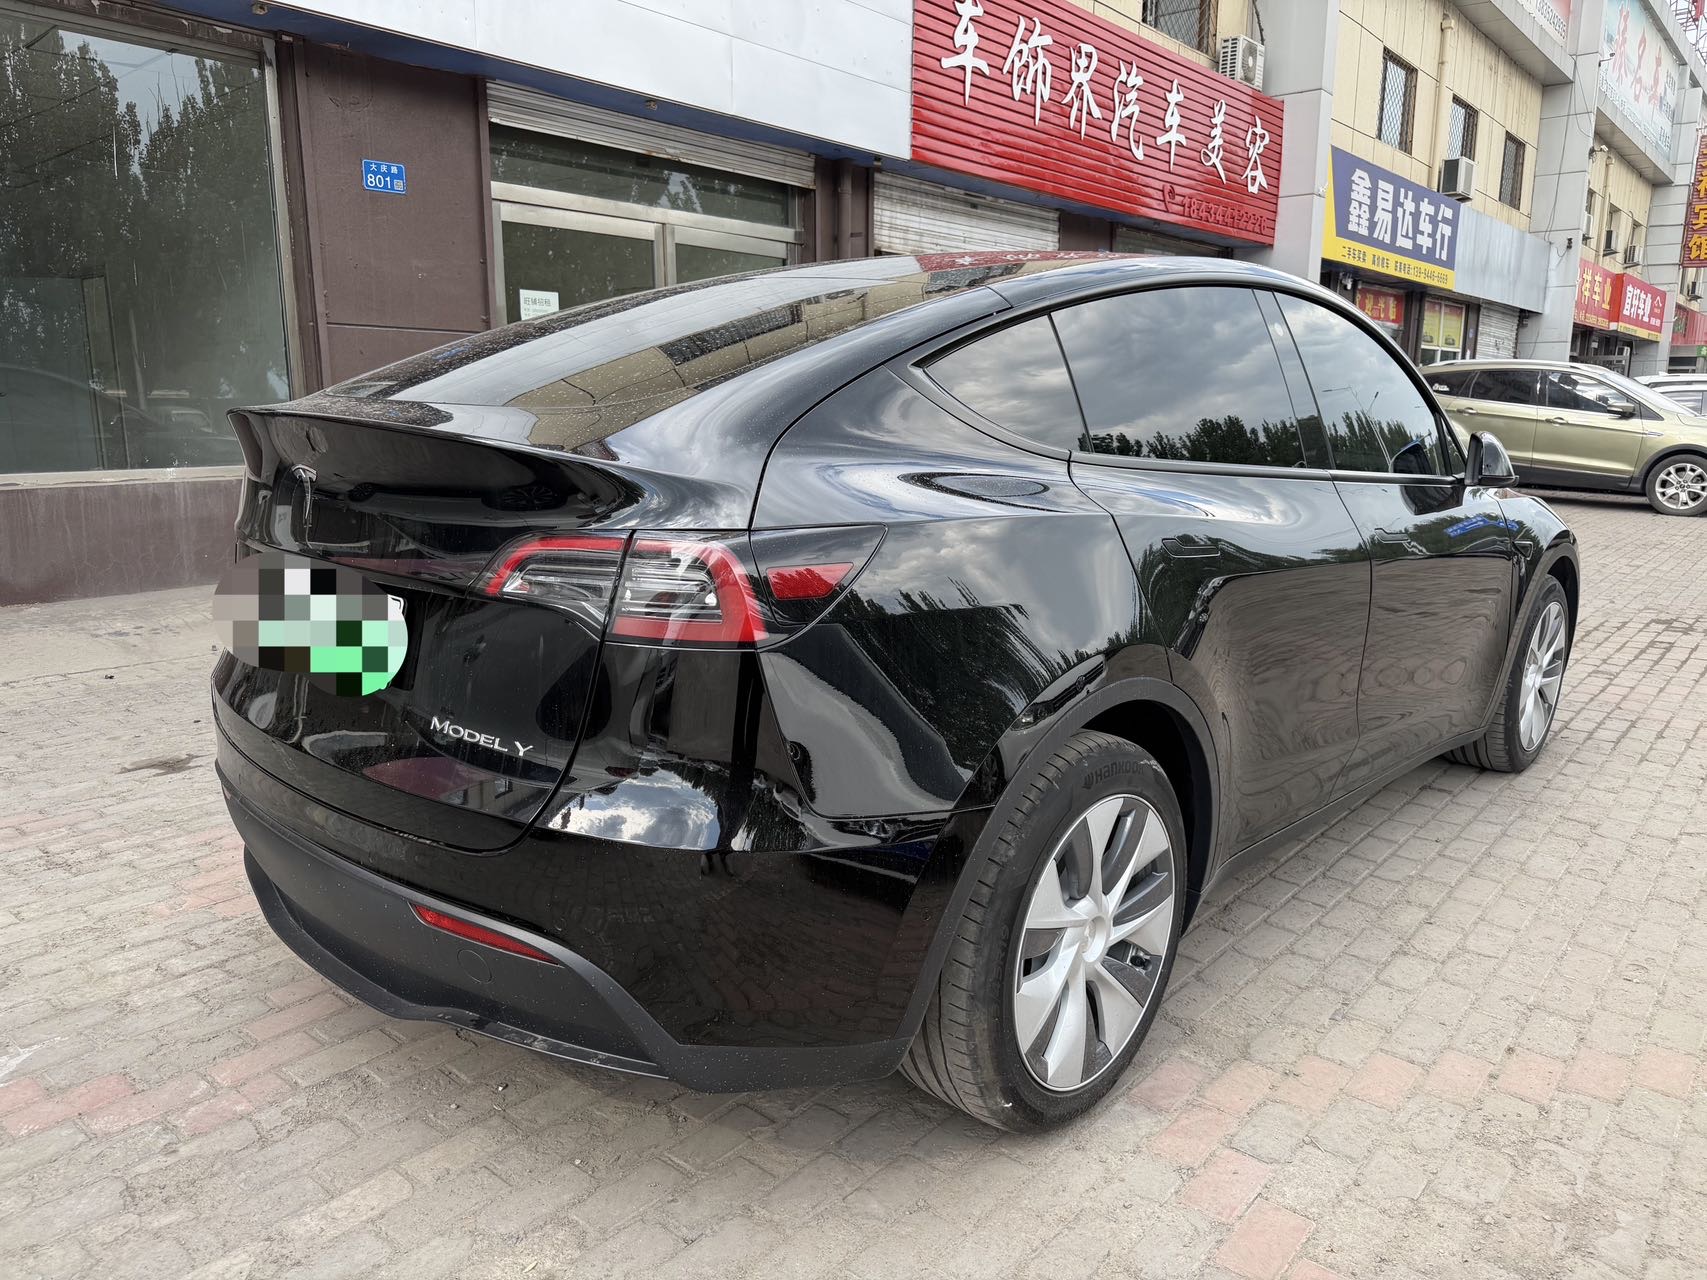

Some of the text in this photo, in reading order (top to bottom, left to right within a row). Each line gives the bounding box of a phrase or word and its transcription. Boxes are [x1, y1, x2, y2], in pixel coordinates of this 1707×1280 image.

[940, 0, 1270, 194] 车饰界汽车美容
[367, 173, 391, 189] 801
[369, 162, 398, 175] 大庆路
[1347, 168, 1454, 262] 鑫易达车行
[430, 715, 534, 757] MODEL Y
